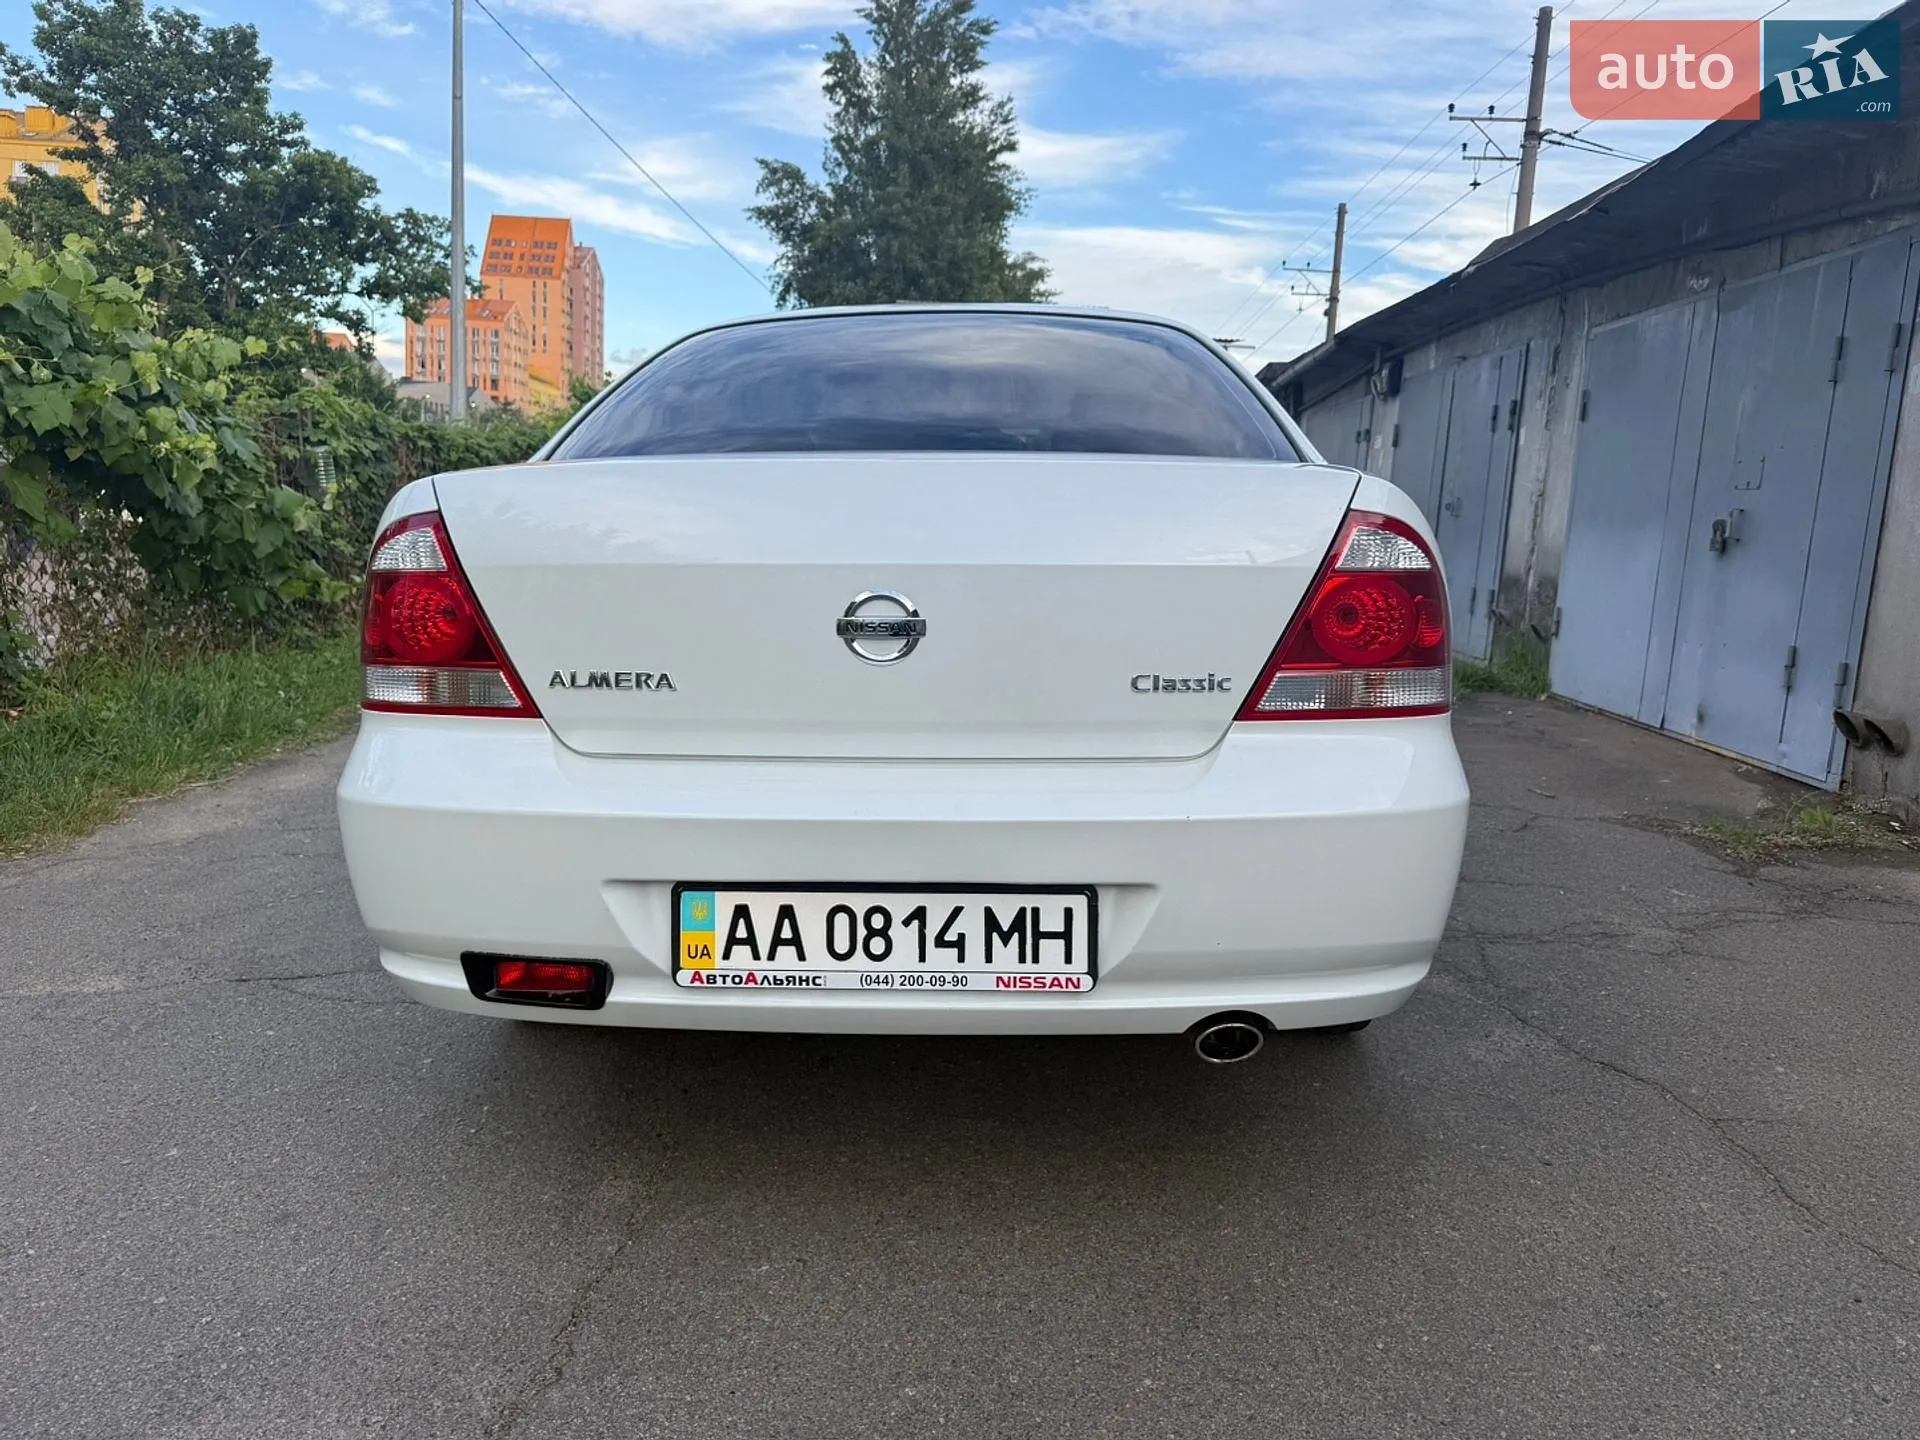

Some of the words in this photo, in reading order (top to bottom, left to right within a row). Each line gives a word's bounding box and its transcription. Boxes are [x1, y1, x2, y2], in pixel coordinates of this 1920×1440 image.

[845, 621, 917, 634] NISSAN
[549, 669, 677, 691] ALMERA
[1130, 672, 1232, 693] Classic
[722, 903, 807, 962] AA
[825, 904, 966, 964] 0814
[983, 905, 1073, 964] MH
[687, 944, 712, 960] UA
[859, 975, 895, 988] (044)
[899, 975, 968, 988] 200-09-90
[995, 976, 1081, 990] NISSAN
